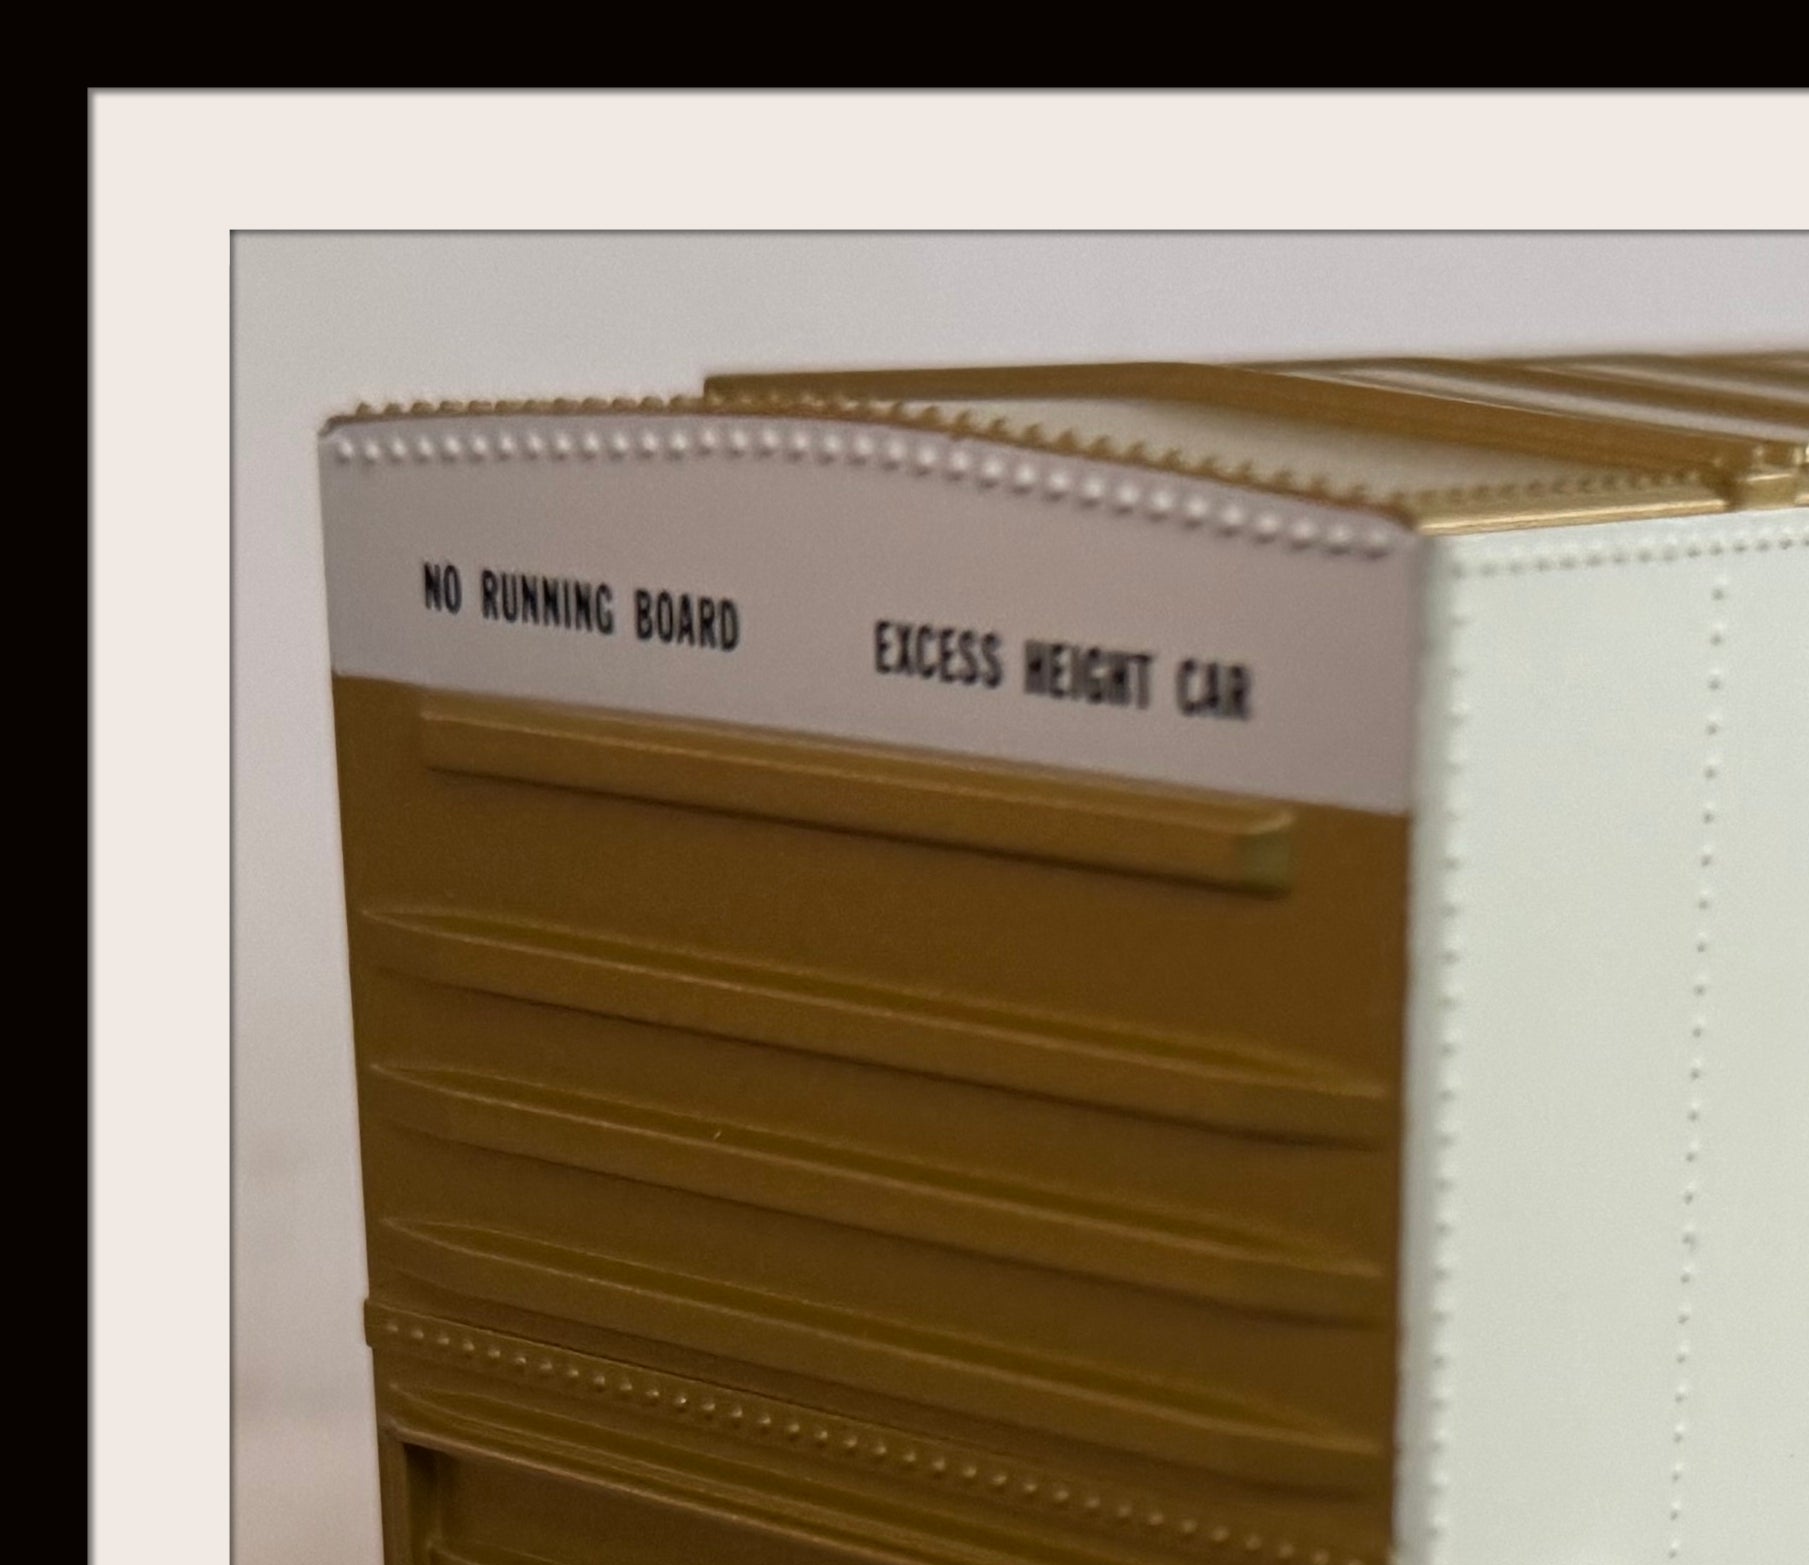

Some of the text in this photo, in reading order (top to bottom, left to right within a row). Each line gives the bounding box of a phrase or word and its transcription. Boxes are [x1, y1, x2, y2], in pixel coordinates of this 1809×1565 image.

[422, 561, 740, 653] NO RUNNING BOARD
[874, 620, 1253, 722] EXCESS HEIGHT CAR
